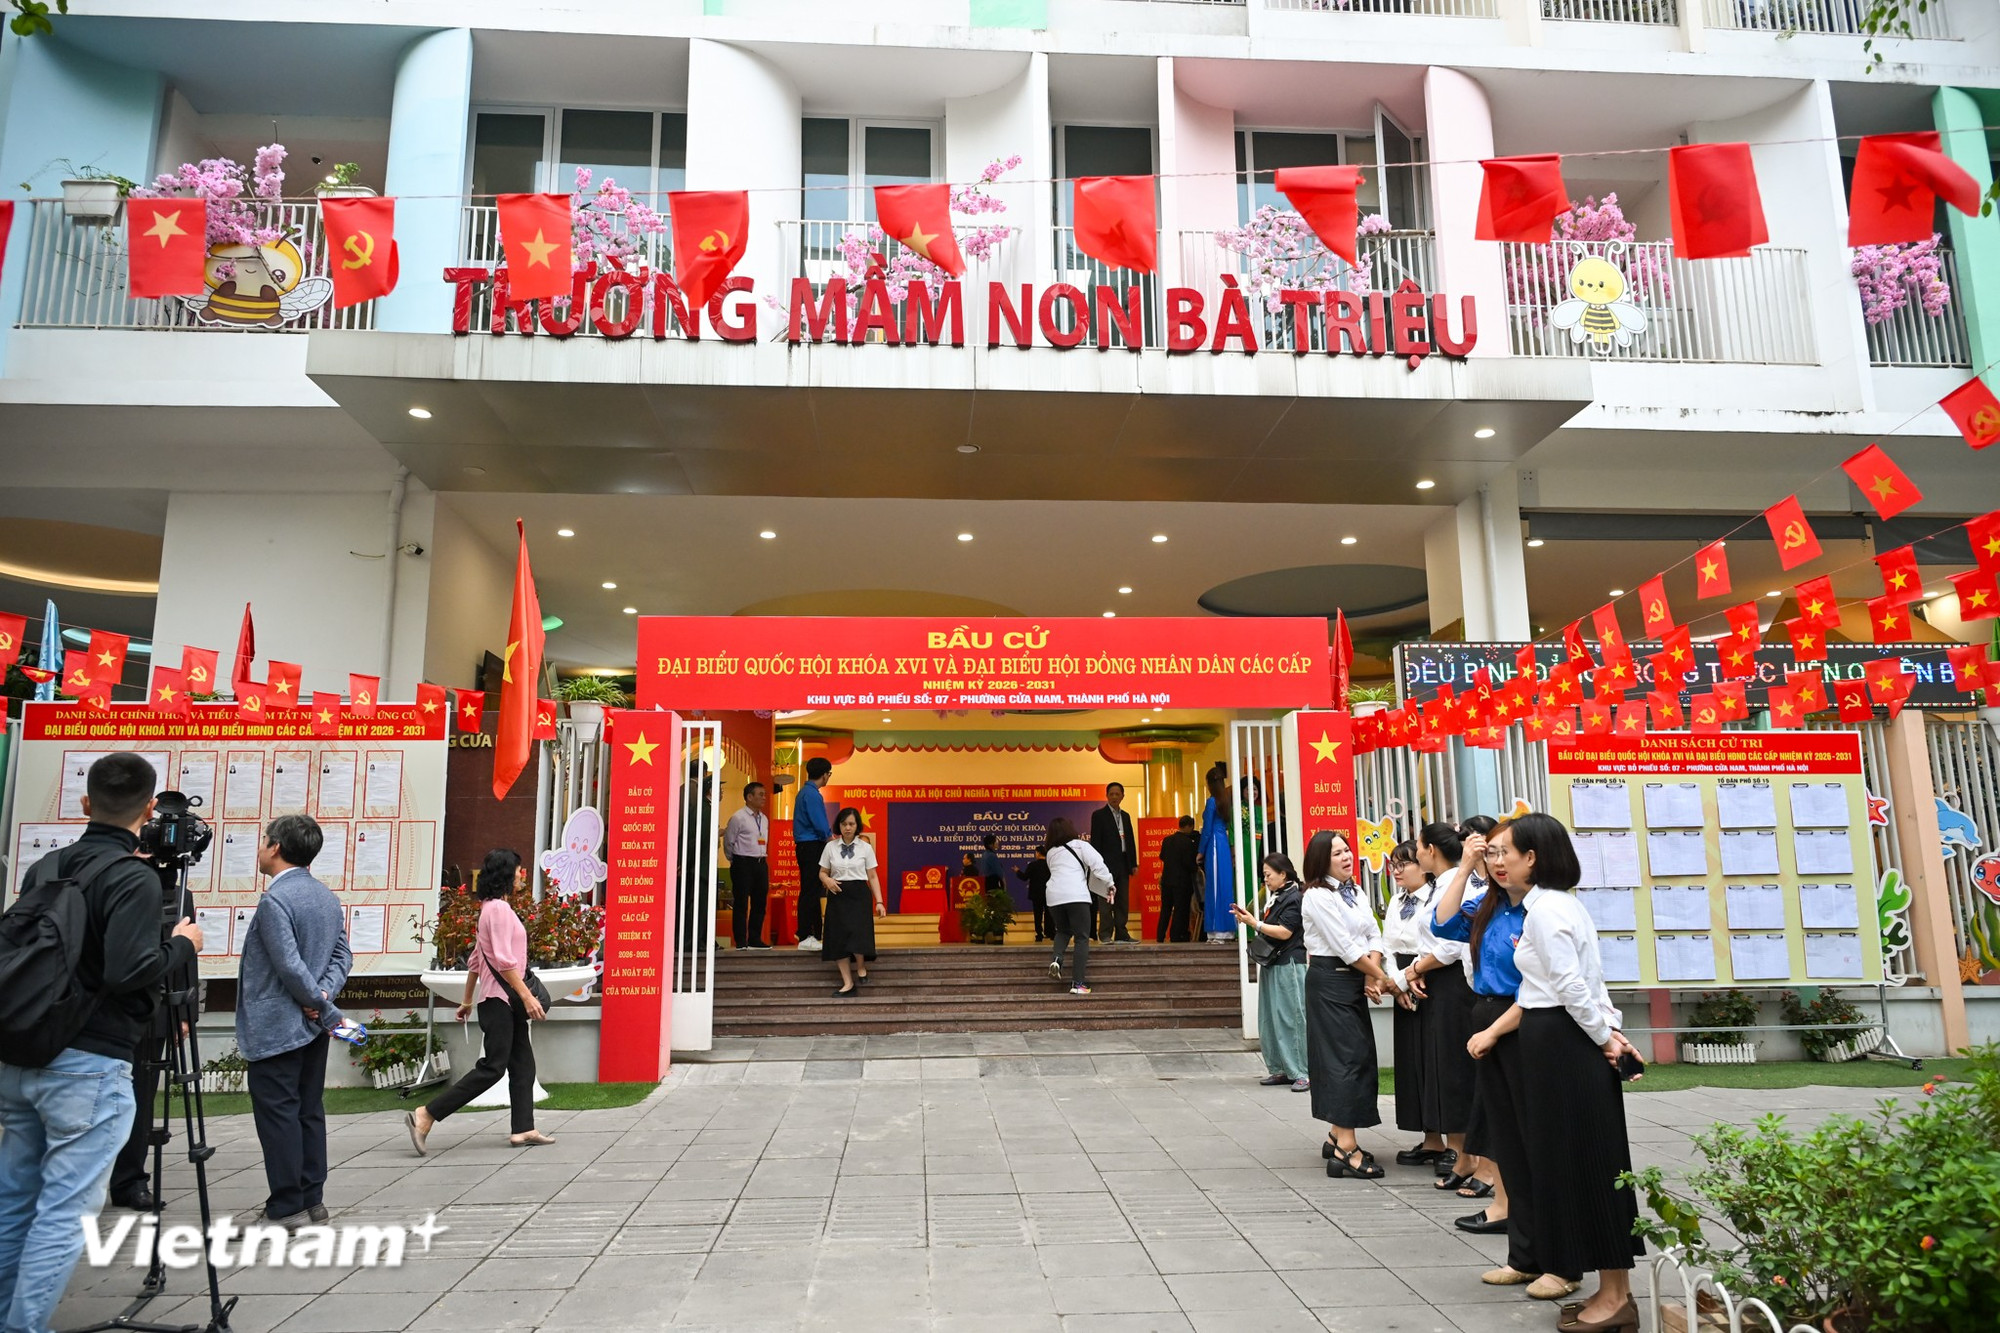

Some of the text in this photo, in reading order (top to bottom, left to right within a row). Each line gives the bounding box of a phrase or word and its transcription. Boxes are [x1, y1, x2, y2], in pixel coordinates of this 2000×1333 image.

[788, 252, 964, 348] MẦM
[988, 281, 1141, 352] NON
[1166, 273, 1259, 356] BÀ
[1280, 278, 1478, 372] TRIỆU
[928, 625, 1050, 649] BẦU CỬ
[658, 650, 1311, 678] ĐẠI BIỂU QUỐC HỘI KHÓA XVI VÀ ĐẠI BIỂU HỘI ĐỒNG NHÂN DÂN CÁC CẤP
[923, 679, 1055, 691] NHIỆM KỲ 2026 2031
[807, 692, 1170, 706] KHU VỰC BỎ PHIẾU SỐ: 07 PHƯỜNG CỬA NAM, THÀNH PHỐ HÀ NỘI
[44, 725, 62, 738] ĐẠI
[64, 721, 87, 736] BIỂU
[90, 721, 116, 736] QUỐC
[119, 724, 136, 738] HỘI
[139, 723, 165, 736] KHOÁ
[168, 725, 184, 736] XVI
[187, 723, 200, 736] VÀ
[202, 725, 218, 738] ĐẠI
[222, 721, 244, 736] BIỂU
[246, 725, 274, 736] HĐND
[276, 723, 296, 736] CÁC
[356, 723, 368, 736] KỲ
[370, 725, 394, 736] 2026
[403, 725, 426, 736] 2031
[1641, 736, 1762, 748] DANH SÁCH CỬ TRI
